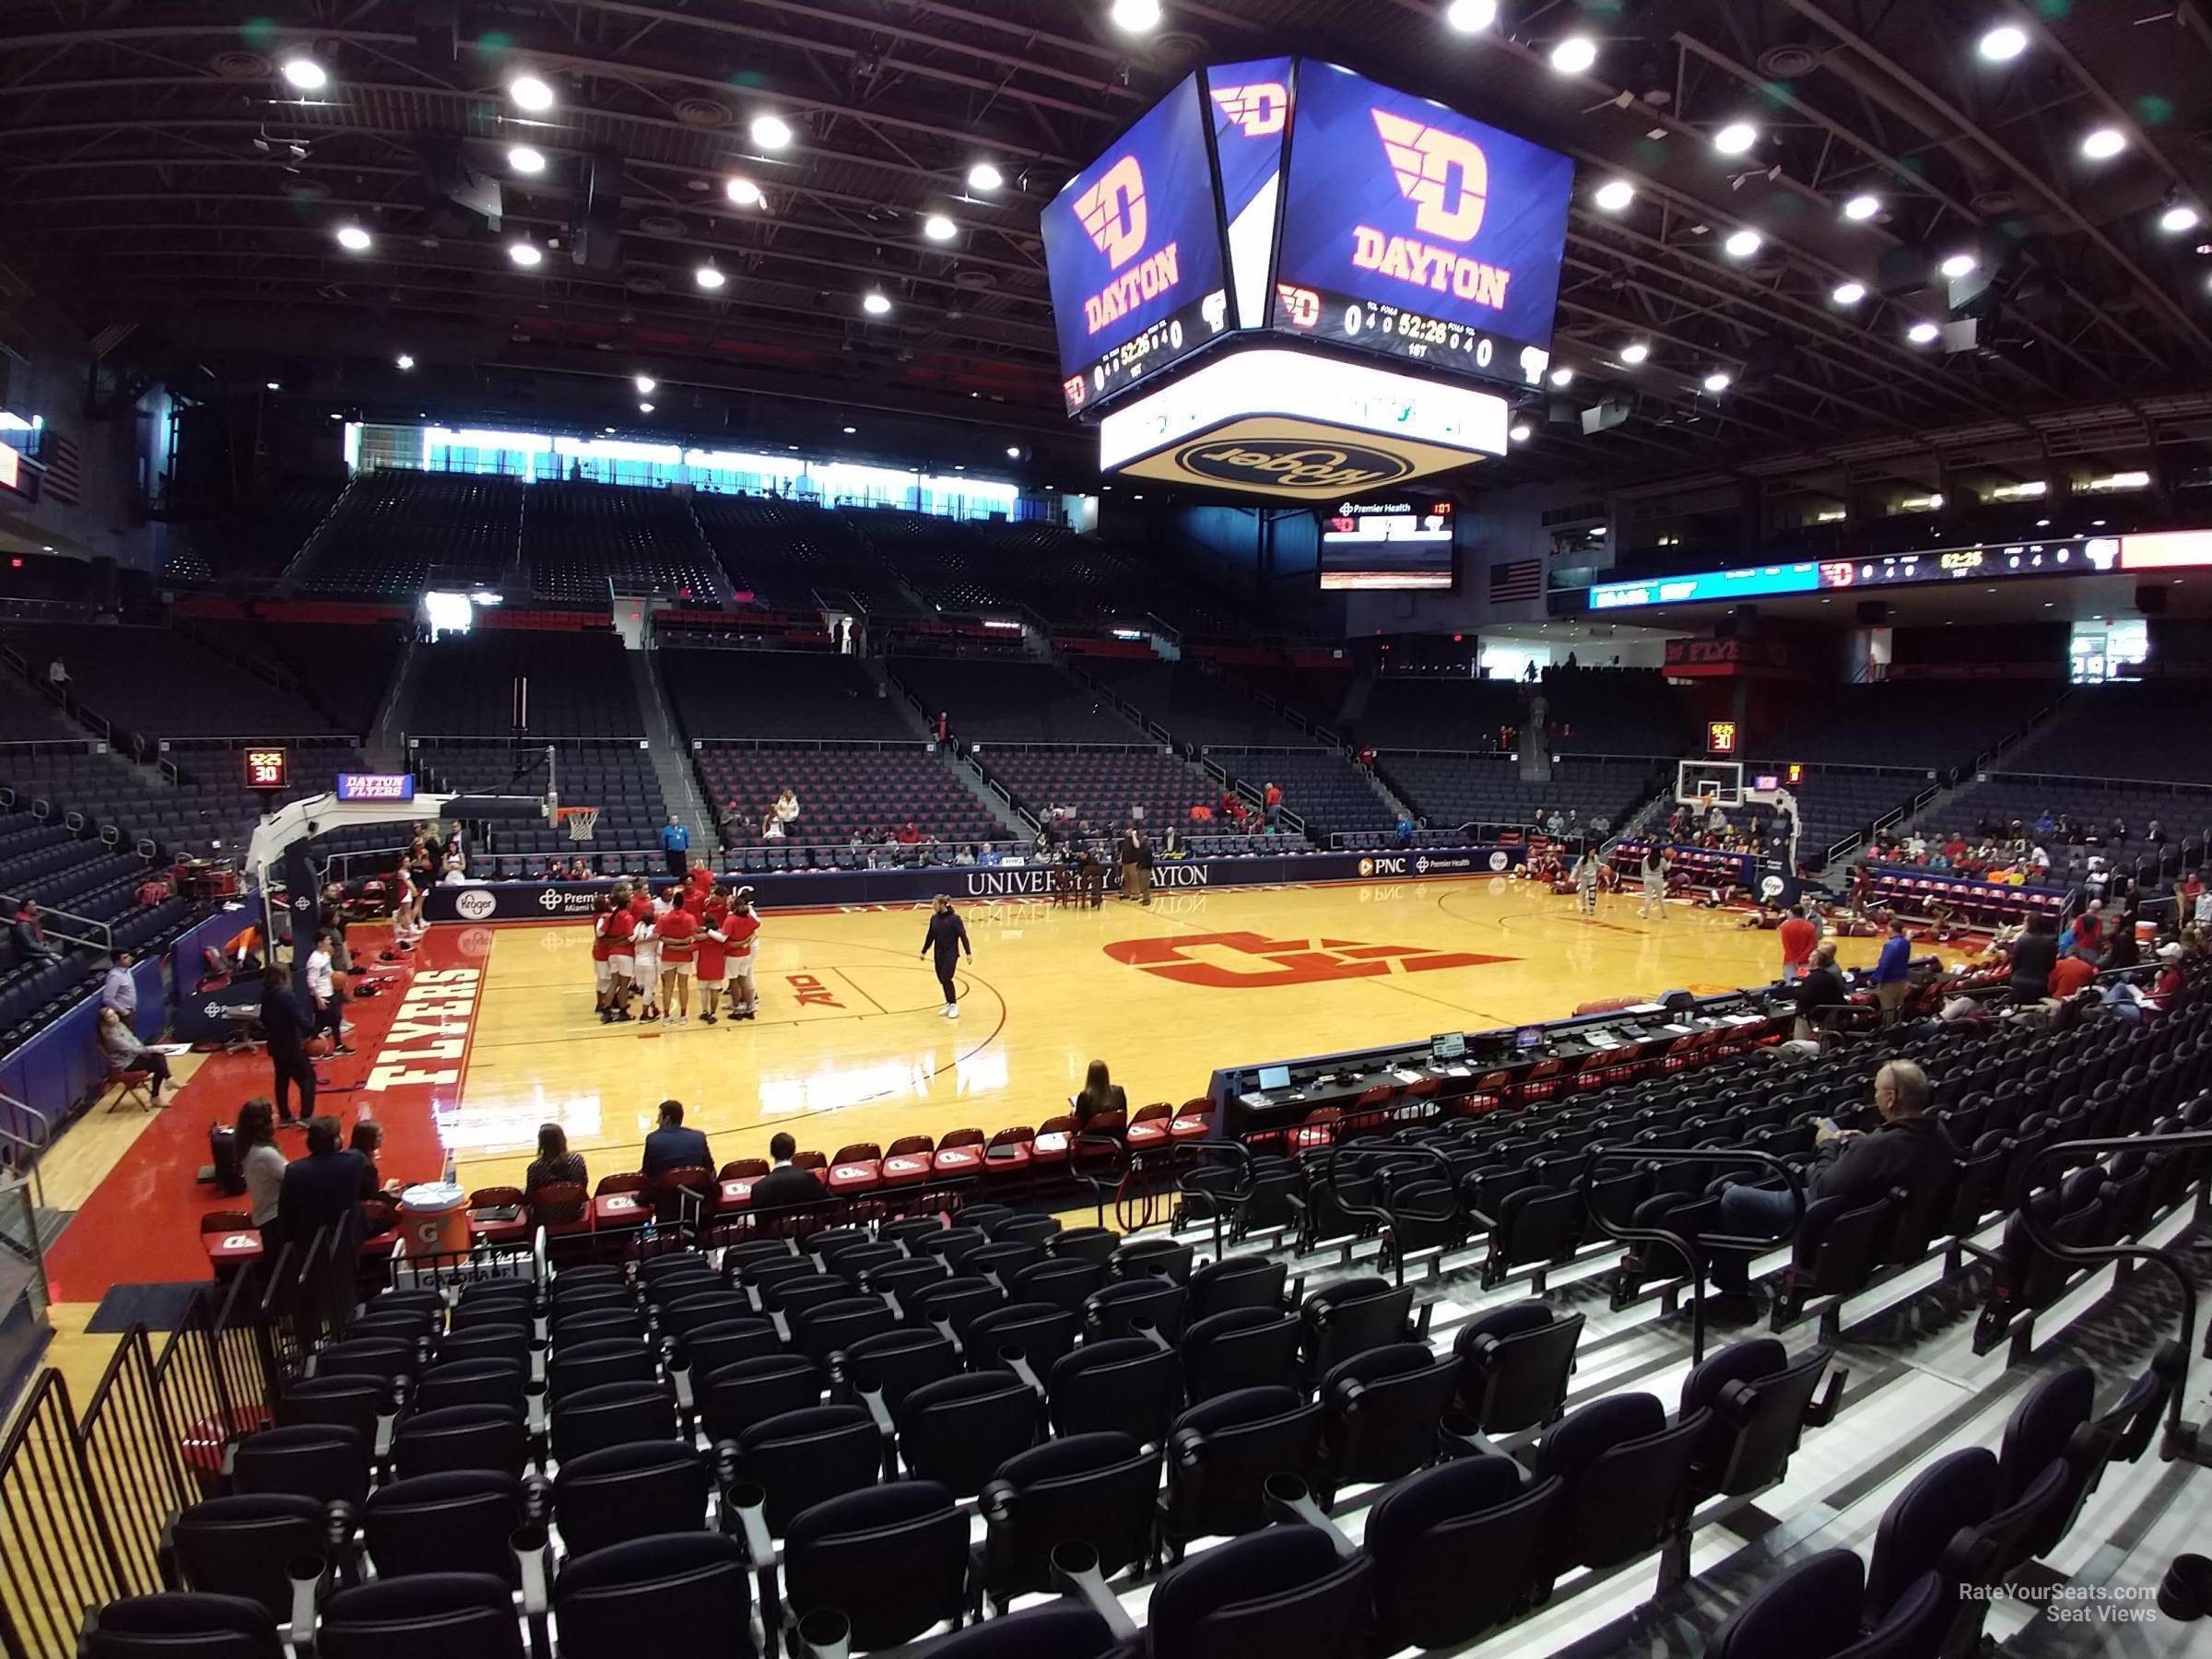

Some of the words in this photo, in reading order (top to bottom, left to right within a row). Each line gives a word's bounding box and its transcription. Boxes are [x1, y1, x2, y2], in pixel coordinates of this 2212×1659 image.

[1352, 226, 1511, 310] DAYTON
[1084, 243, 1179, 335] DAYTON
[1171, 320, 1182, 348] 0
[1345, 305, 1362, 335] 0
[1366, 313, 1376, 329] 4
[1383, 317, 1393, 333] 0
[1450, 334, 1460, 349] 0
[1464, 337, 1474, 353] 4
[1477, 339, 1492, 367] 0
[1201, 448, 1385, 486] Kroger
[1354, 504, 1383, 513] Premier
[1384, 503, 1411, 512] Health
[255, 766, 276, 782] 30
[346, 776, 405, 787] DAYTON
[347, 787, 403, 797] FLYERS
[1148, 865, 1208, 887] AYTON
[1374, 858, 1406, 874] PNC
[461, 894, 492, 915] Kroger
[364, 968, 479, 1091] FLYERS
[418, 1223, 439, 1242] G
